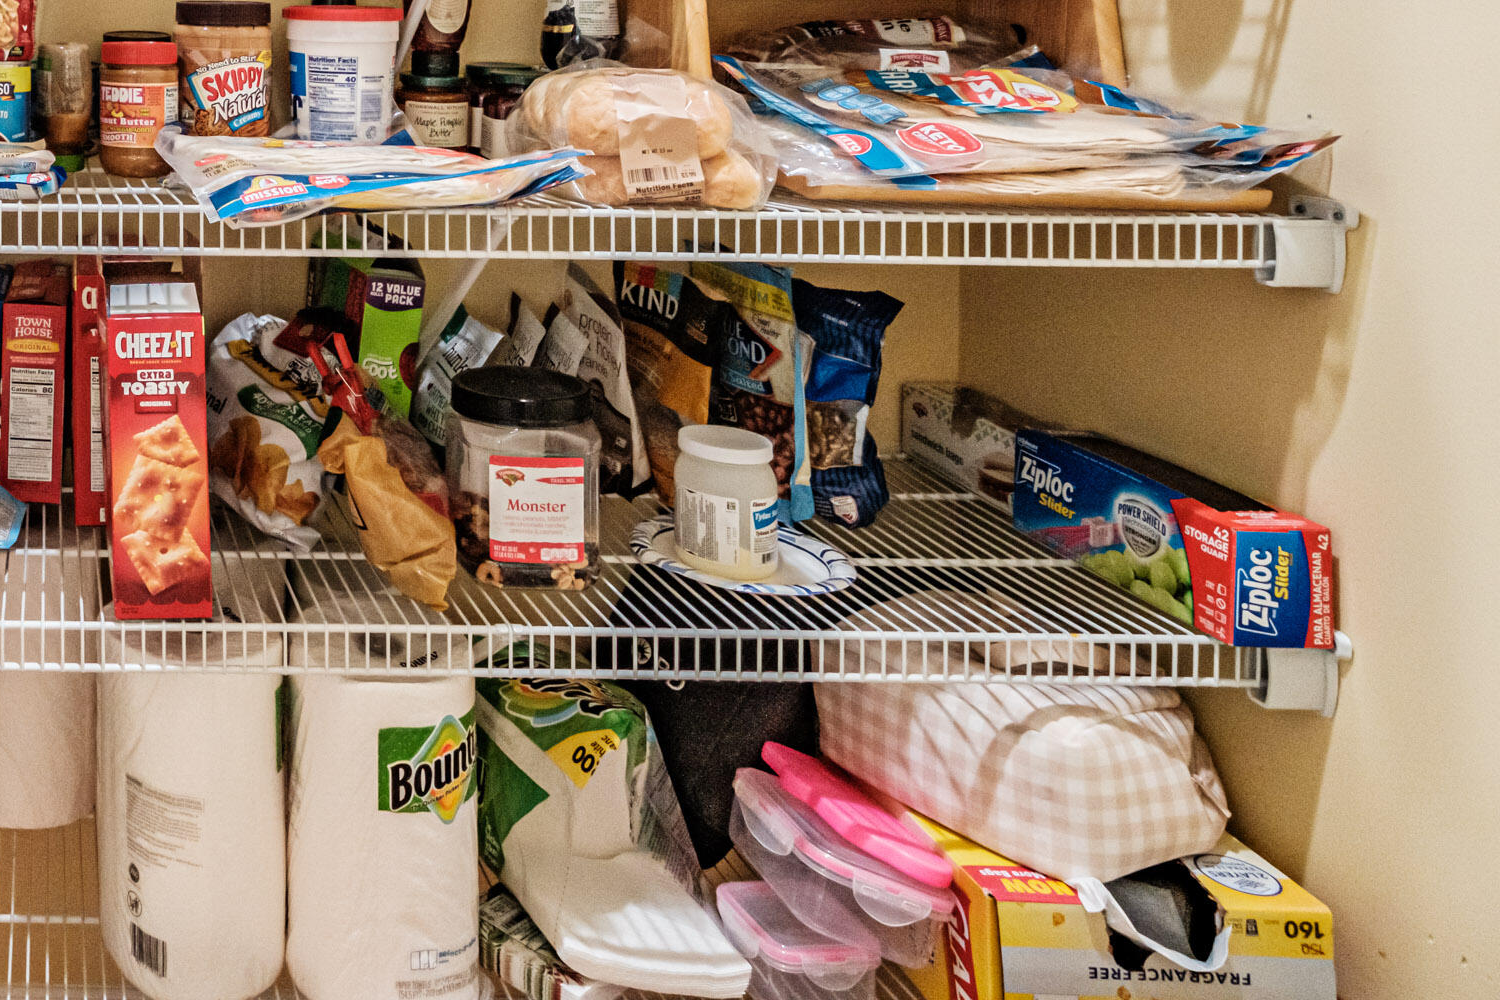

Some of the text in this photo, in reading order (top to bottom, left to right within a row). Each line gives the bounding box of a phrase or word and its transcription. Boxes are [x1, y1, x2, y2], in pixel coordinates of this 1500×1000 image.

[308, 56, 338, 64] Nutrition
[201, 65, 264, 102] SKIPPY
[213, 85, 268, 125] Natural
[126, 118, 156, 126] Butter
[233, 112, 261, 128] Creamy
[920, 124, 966, 152] KETO
[244, 184, 306, 203] mission
[636, 184, 670, 194] Nutrition
[371, 282, 422, 297] 12 VALUE
[384, 294, 414, 306] PACK
[620, 278, 679, 320] KIND
[15, 317, 52, 328] TOWN
[15, 327, 53, 339] HOUSE
[13, 343, 51, 351] ORIGINAL
[1021, 456, 1074, 503] Ziploc
[507, 499, 566, 512] Monster
[1038, 493, 1076, 520] Slider
[1184, 525, 1229, 553] STORAGE
[1214, 526, 1229, 541] 42
[1318, 534, 1329, 550] 42
[1200, 544, 1229, 562] QUART
[1274, 546, 1290, 600] Slider
[1241, 549, 1279, 627] Ziploc
[1312, 551, 1323, 645] PARA ALMACENAR
[1323, 617, 1331, 645] CUARTO
[1284, 920, 1324, 938] 160
[1088, 966, 1251, 985] FRAGRANCE FREE
